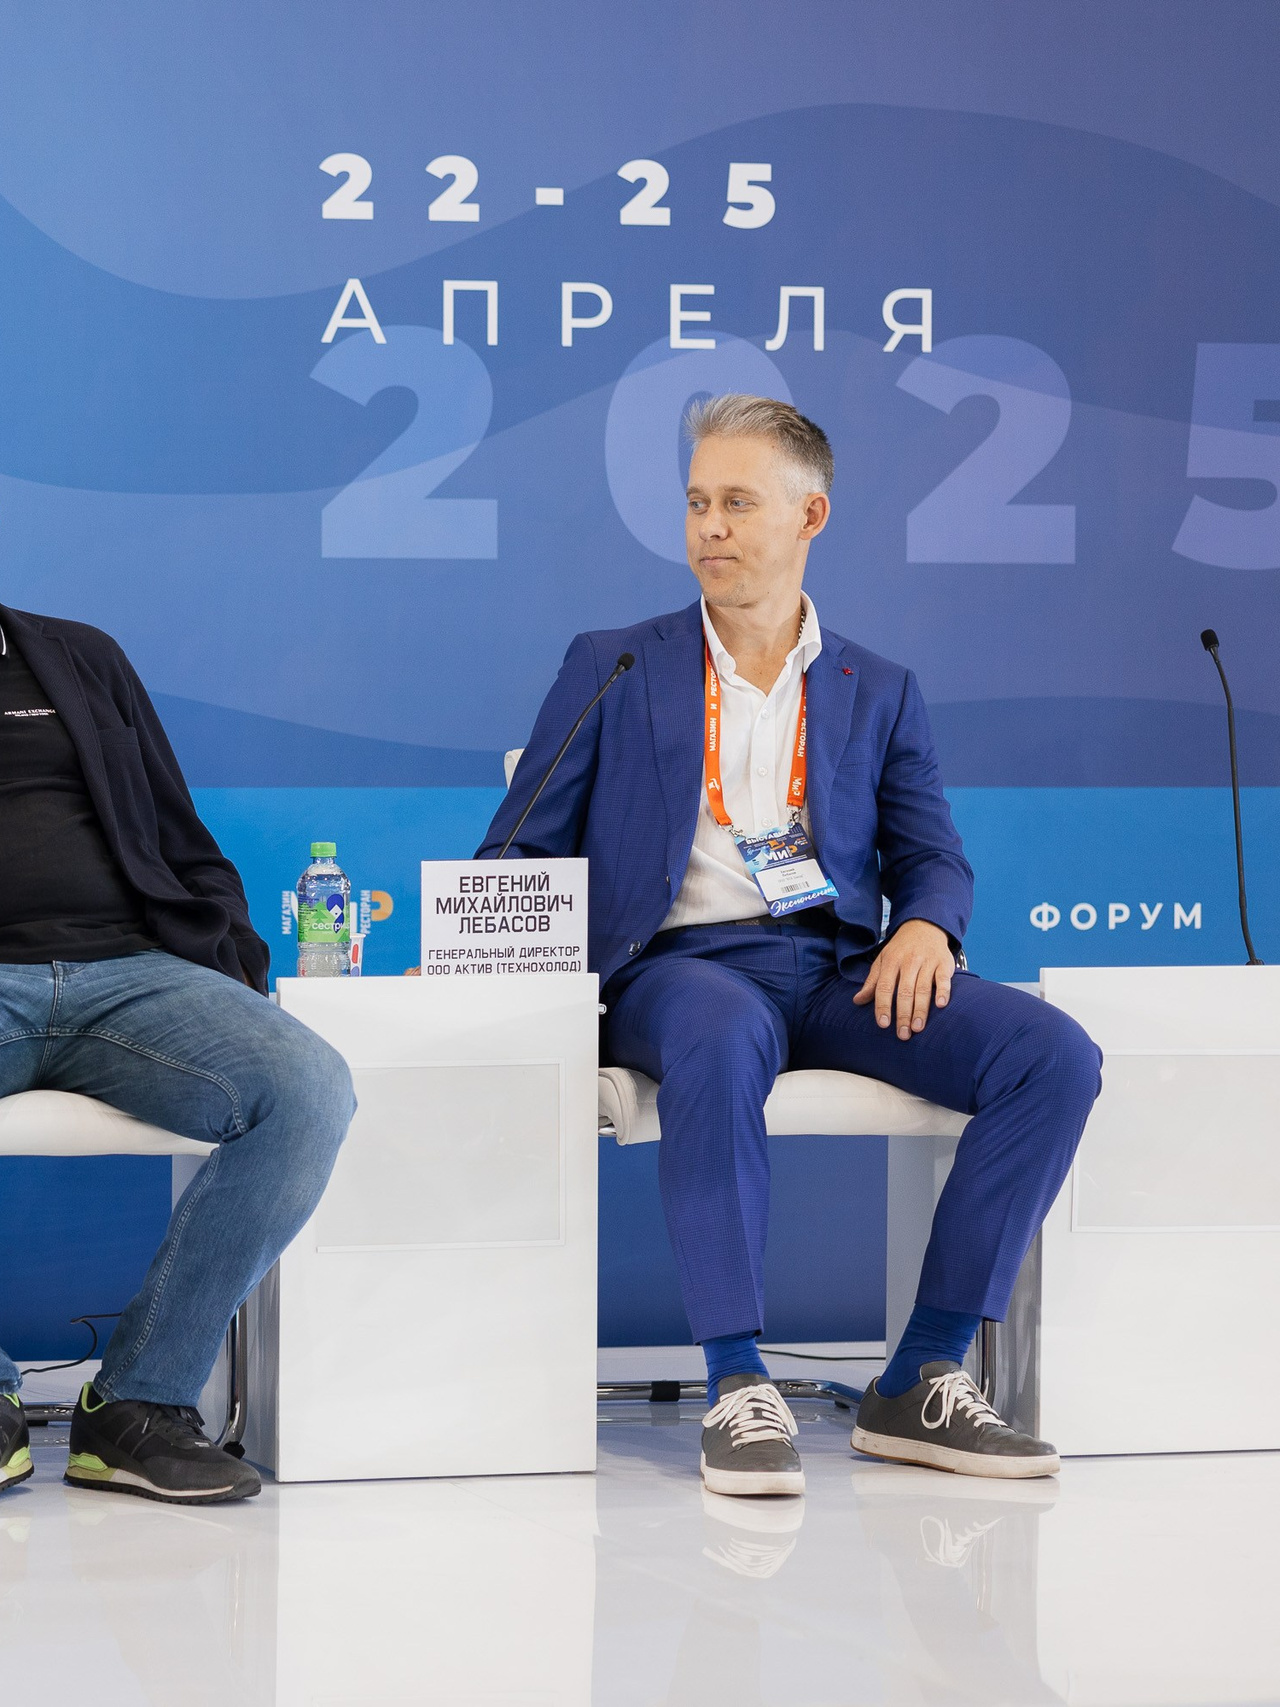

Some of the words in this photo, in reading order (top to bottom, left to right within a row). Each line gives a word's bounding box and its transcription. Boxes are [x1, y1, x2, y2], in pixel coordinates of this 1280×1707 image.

[319, 152, 777, 229] 22-25
[321, 278, 933, 353] АПРЕЛЯ
[709, 717, 717, 751] МАГАЗИН
[459, 871, 550, 894] ЕВГЕНИЙ
[281, 890, 292, 935] МАГАЗИН
[360, 889, 372, 934] РЕСТОРАН
[435, 892, 573, 915] МИХАЙЛОВИЧ
[1029, 902, 1202, 931] ФОРУМ
[458, 914, 550, 935] ЛЕБАСОВ
[428, 946, 515, 960] ГЕНЕРАЛЬНЫЙ
[519, 946, 580, 960] ДИРЕКТОР
[454, 963, 492, 975] АКТИВ
